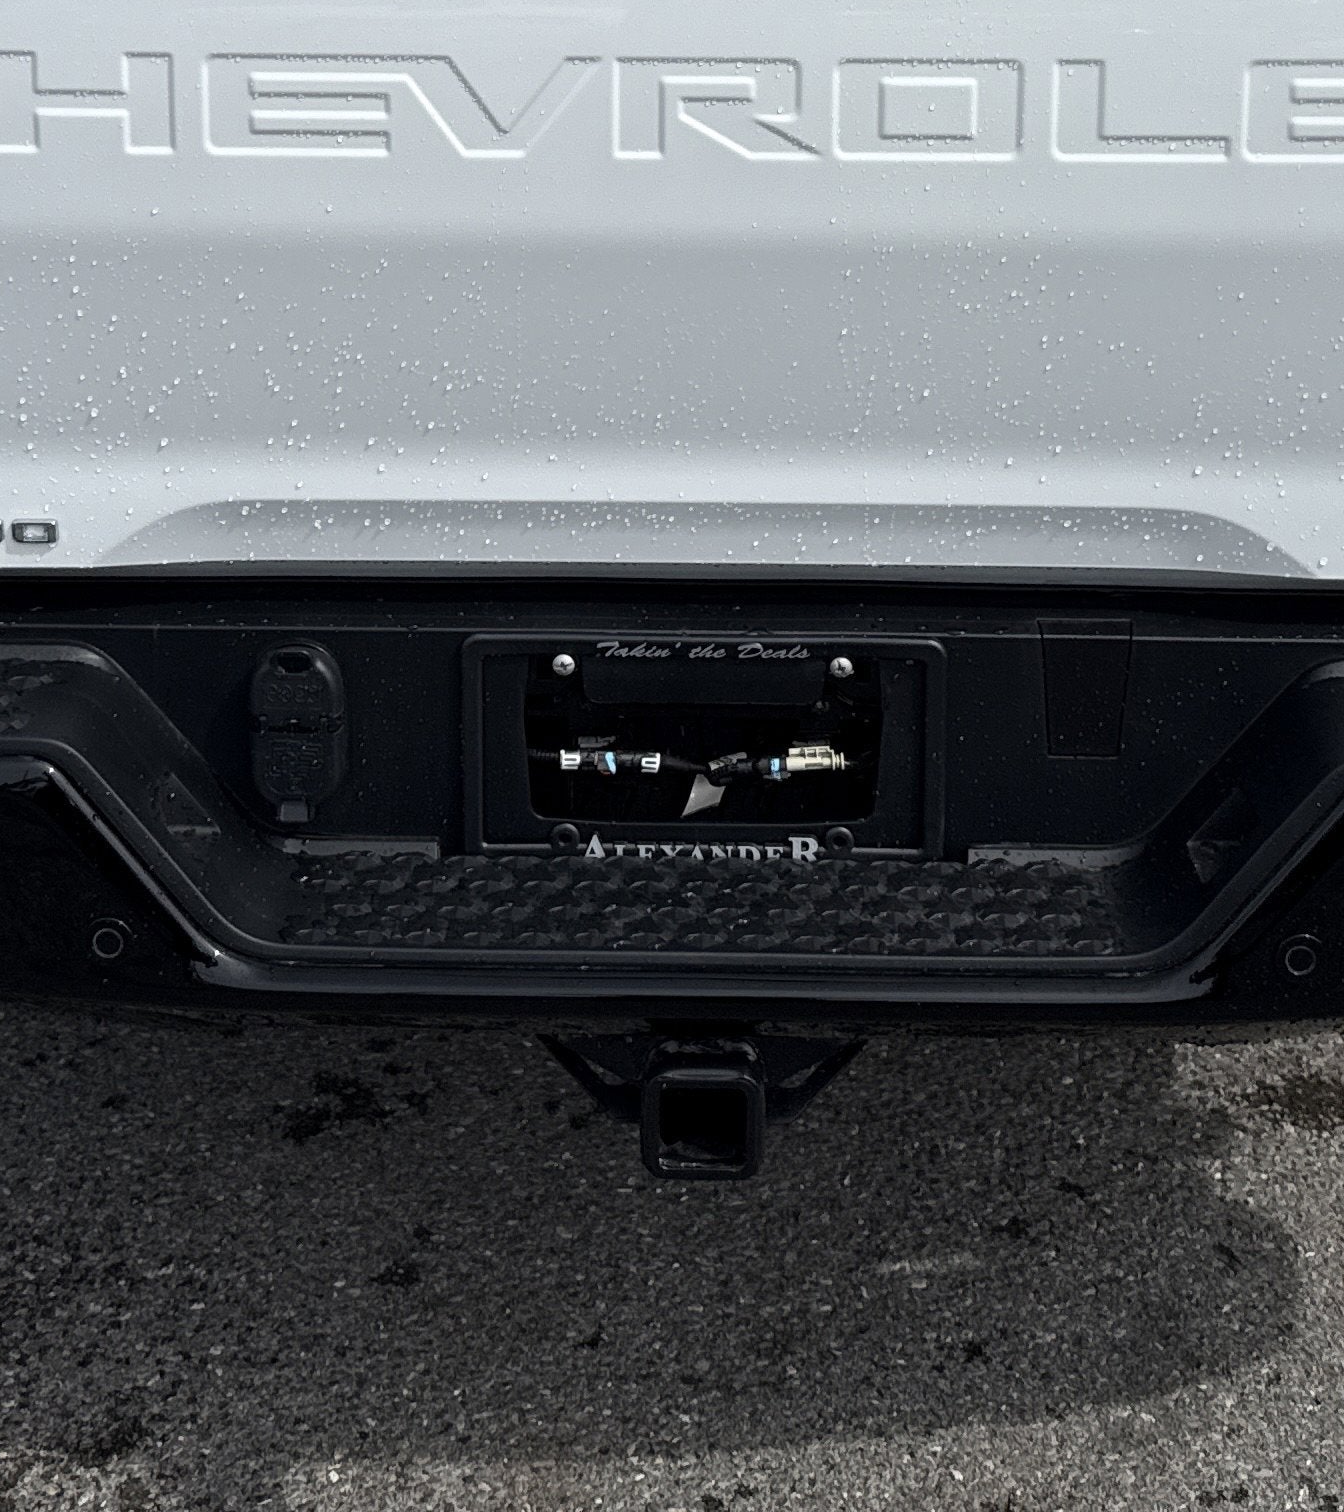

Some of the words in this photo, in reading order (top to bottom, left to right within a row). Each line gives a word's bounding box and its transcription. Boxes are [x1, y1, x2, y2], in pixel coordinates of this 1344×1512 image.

[596, 640, 682, 659] Takin'
[688, 642, 727, 659] the
[737, 641, 811, 660] Deals
